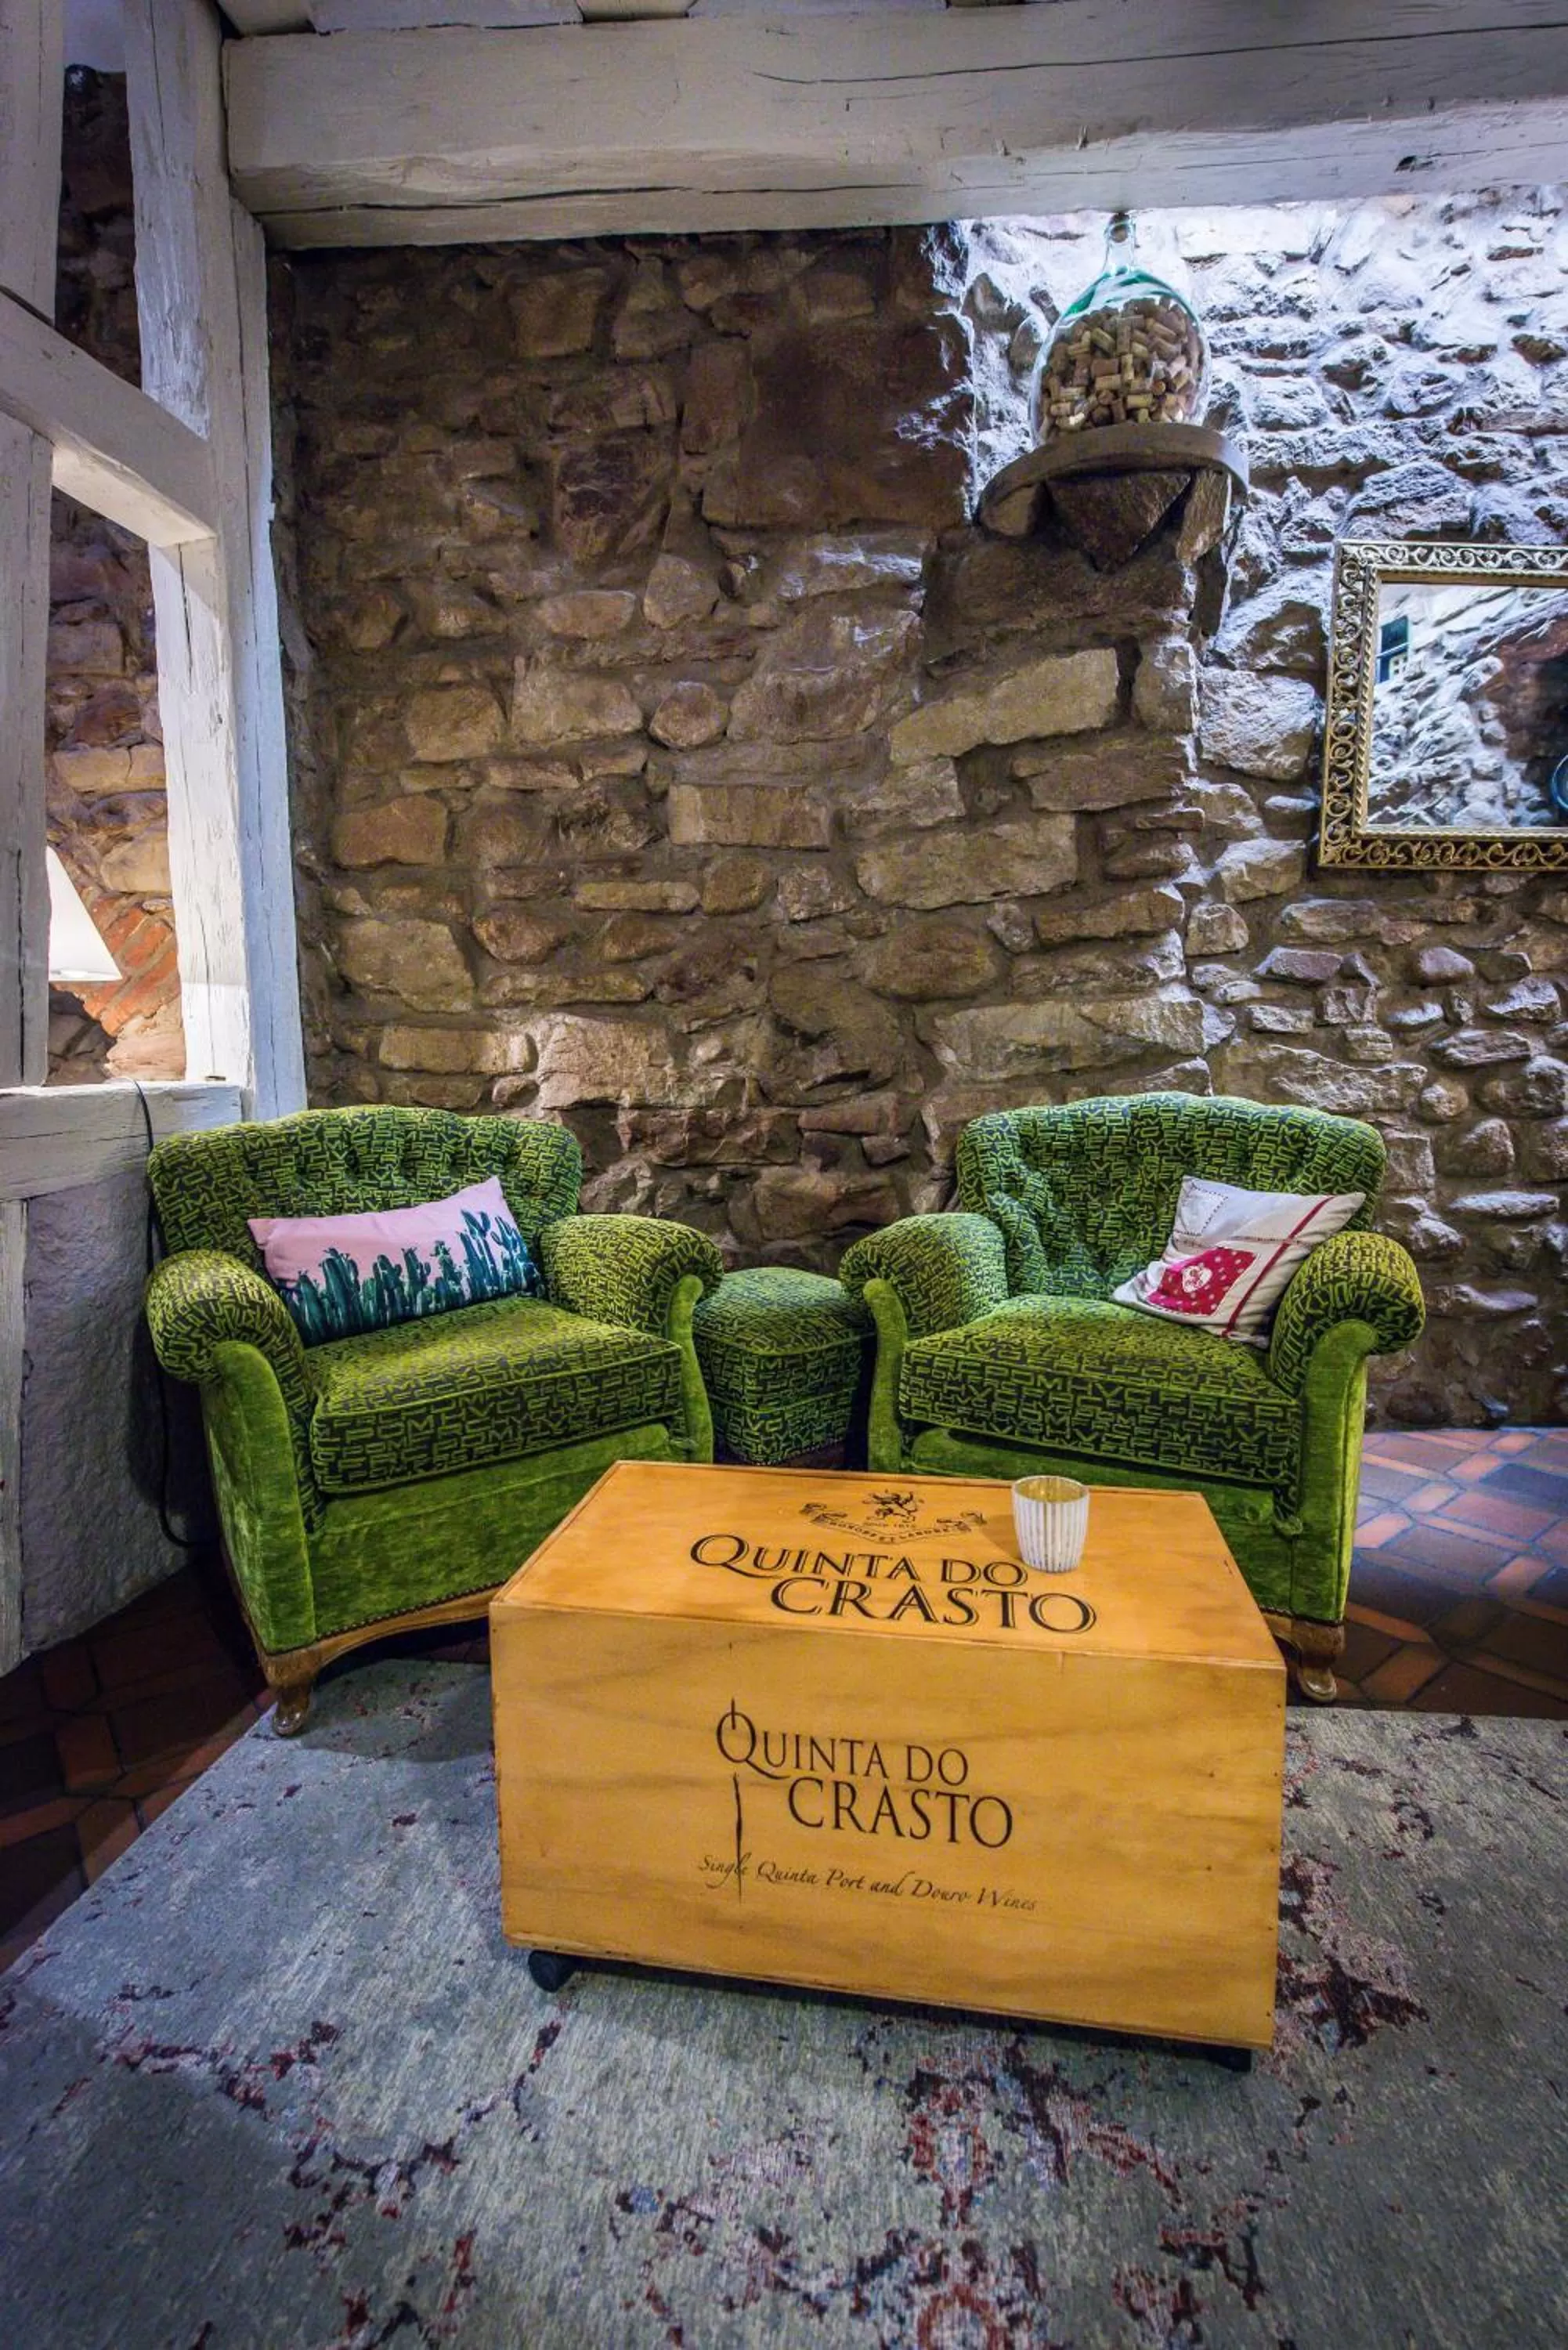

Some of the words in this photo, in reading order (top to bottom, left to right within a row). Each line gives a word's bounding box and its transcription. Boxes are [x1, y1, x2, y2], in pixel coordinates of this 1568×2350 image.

[691, 1534, 922, 1579] QUINTA
[941, 1557, 1027, 1586] DO
[771, 1577, 1097, 1633] CRASTO
[716, 1708, 888, 1780] QUINTA
[906, 1744, 968, 1786] DO
[788, 1777, 1013, 1849] CRASTO
[699, 1852, 752, 1889] Single
[757, 1860, 819, 1885] Quinta
[826, 1868, 865, 1890] Port
[871, 1871, 915, 1896] and
[912, 1880, 968, 1902] Douro
[977, 1887, 1037, 1911] Wines
